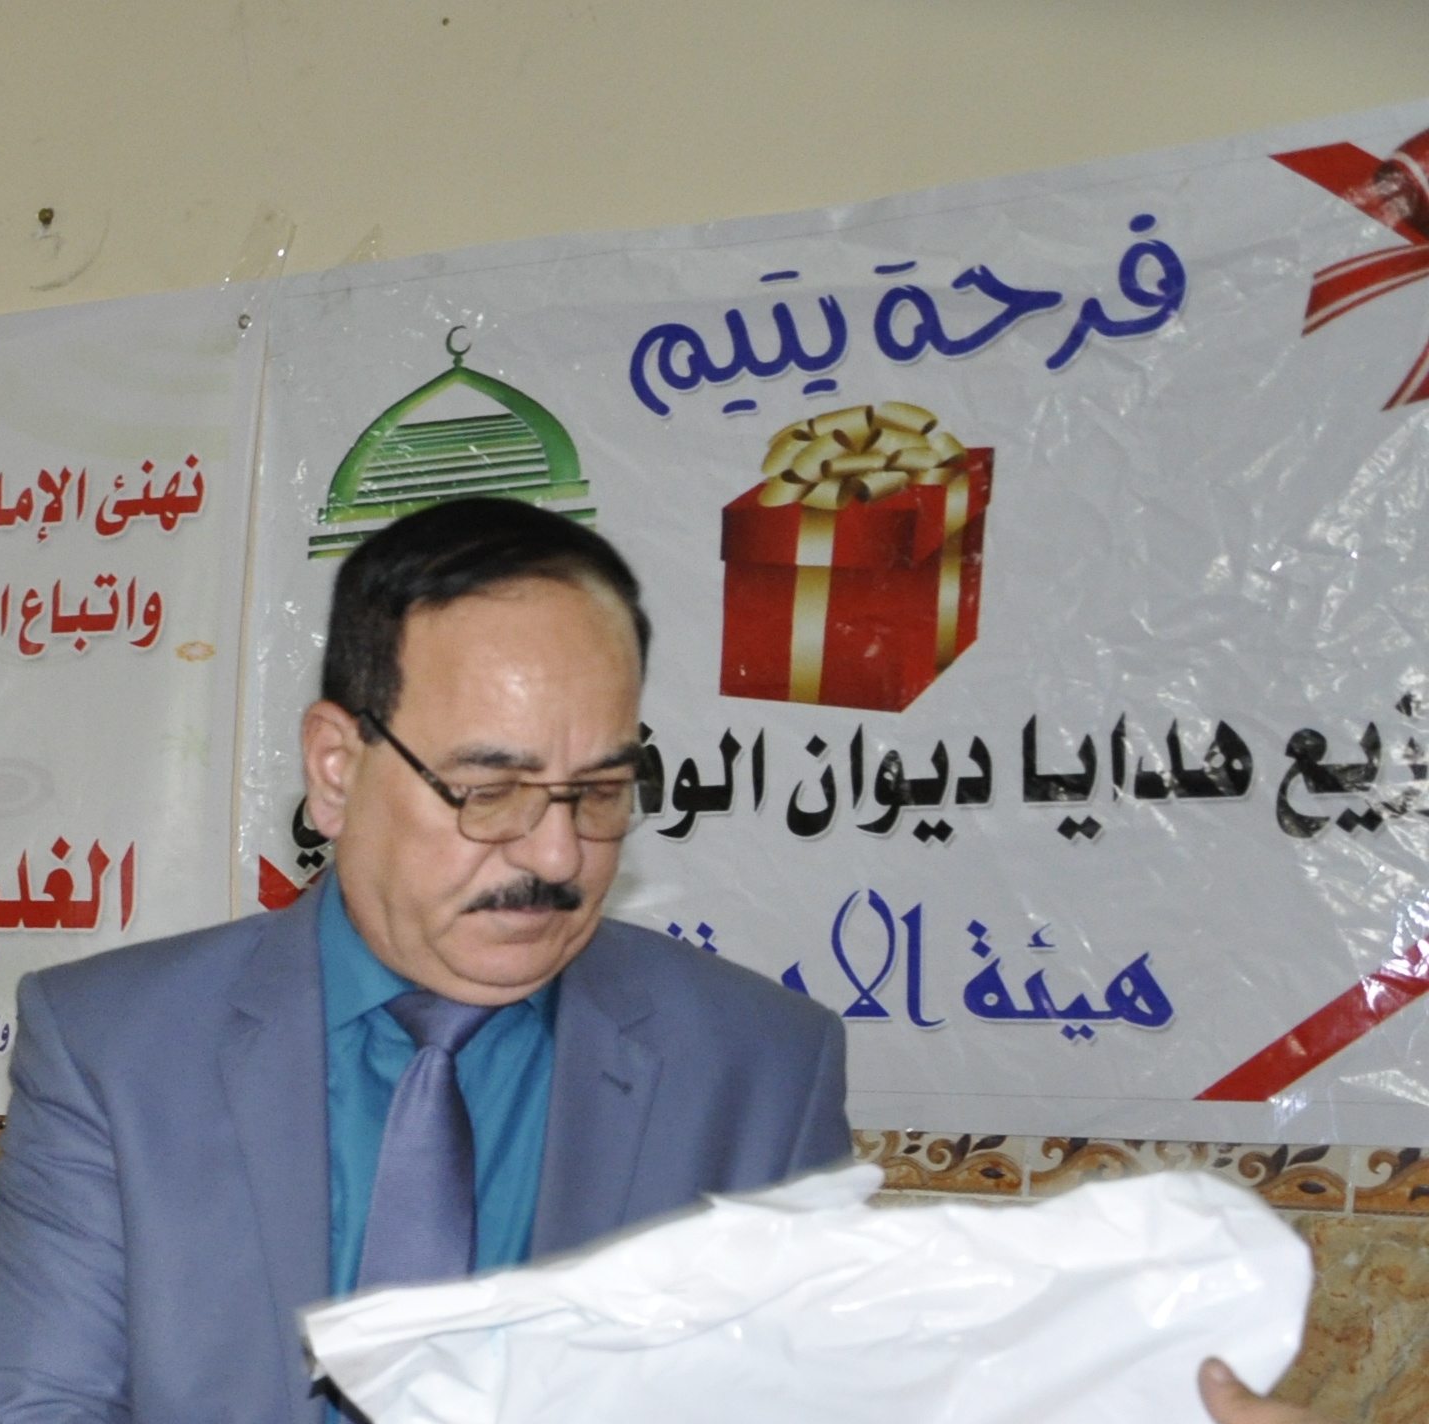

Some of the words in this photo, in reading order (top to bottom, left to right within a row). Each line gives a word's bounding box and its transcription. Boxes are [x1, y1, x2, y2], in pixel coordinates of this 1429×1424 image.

[628, 269, 849, 418] يتيم
[873, 211, 1190, 372] فرحة
[786, 722, 993, 845] ديوان
[1020, 711, 1254, 843] هدايا
